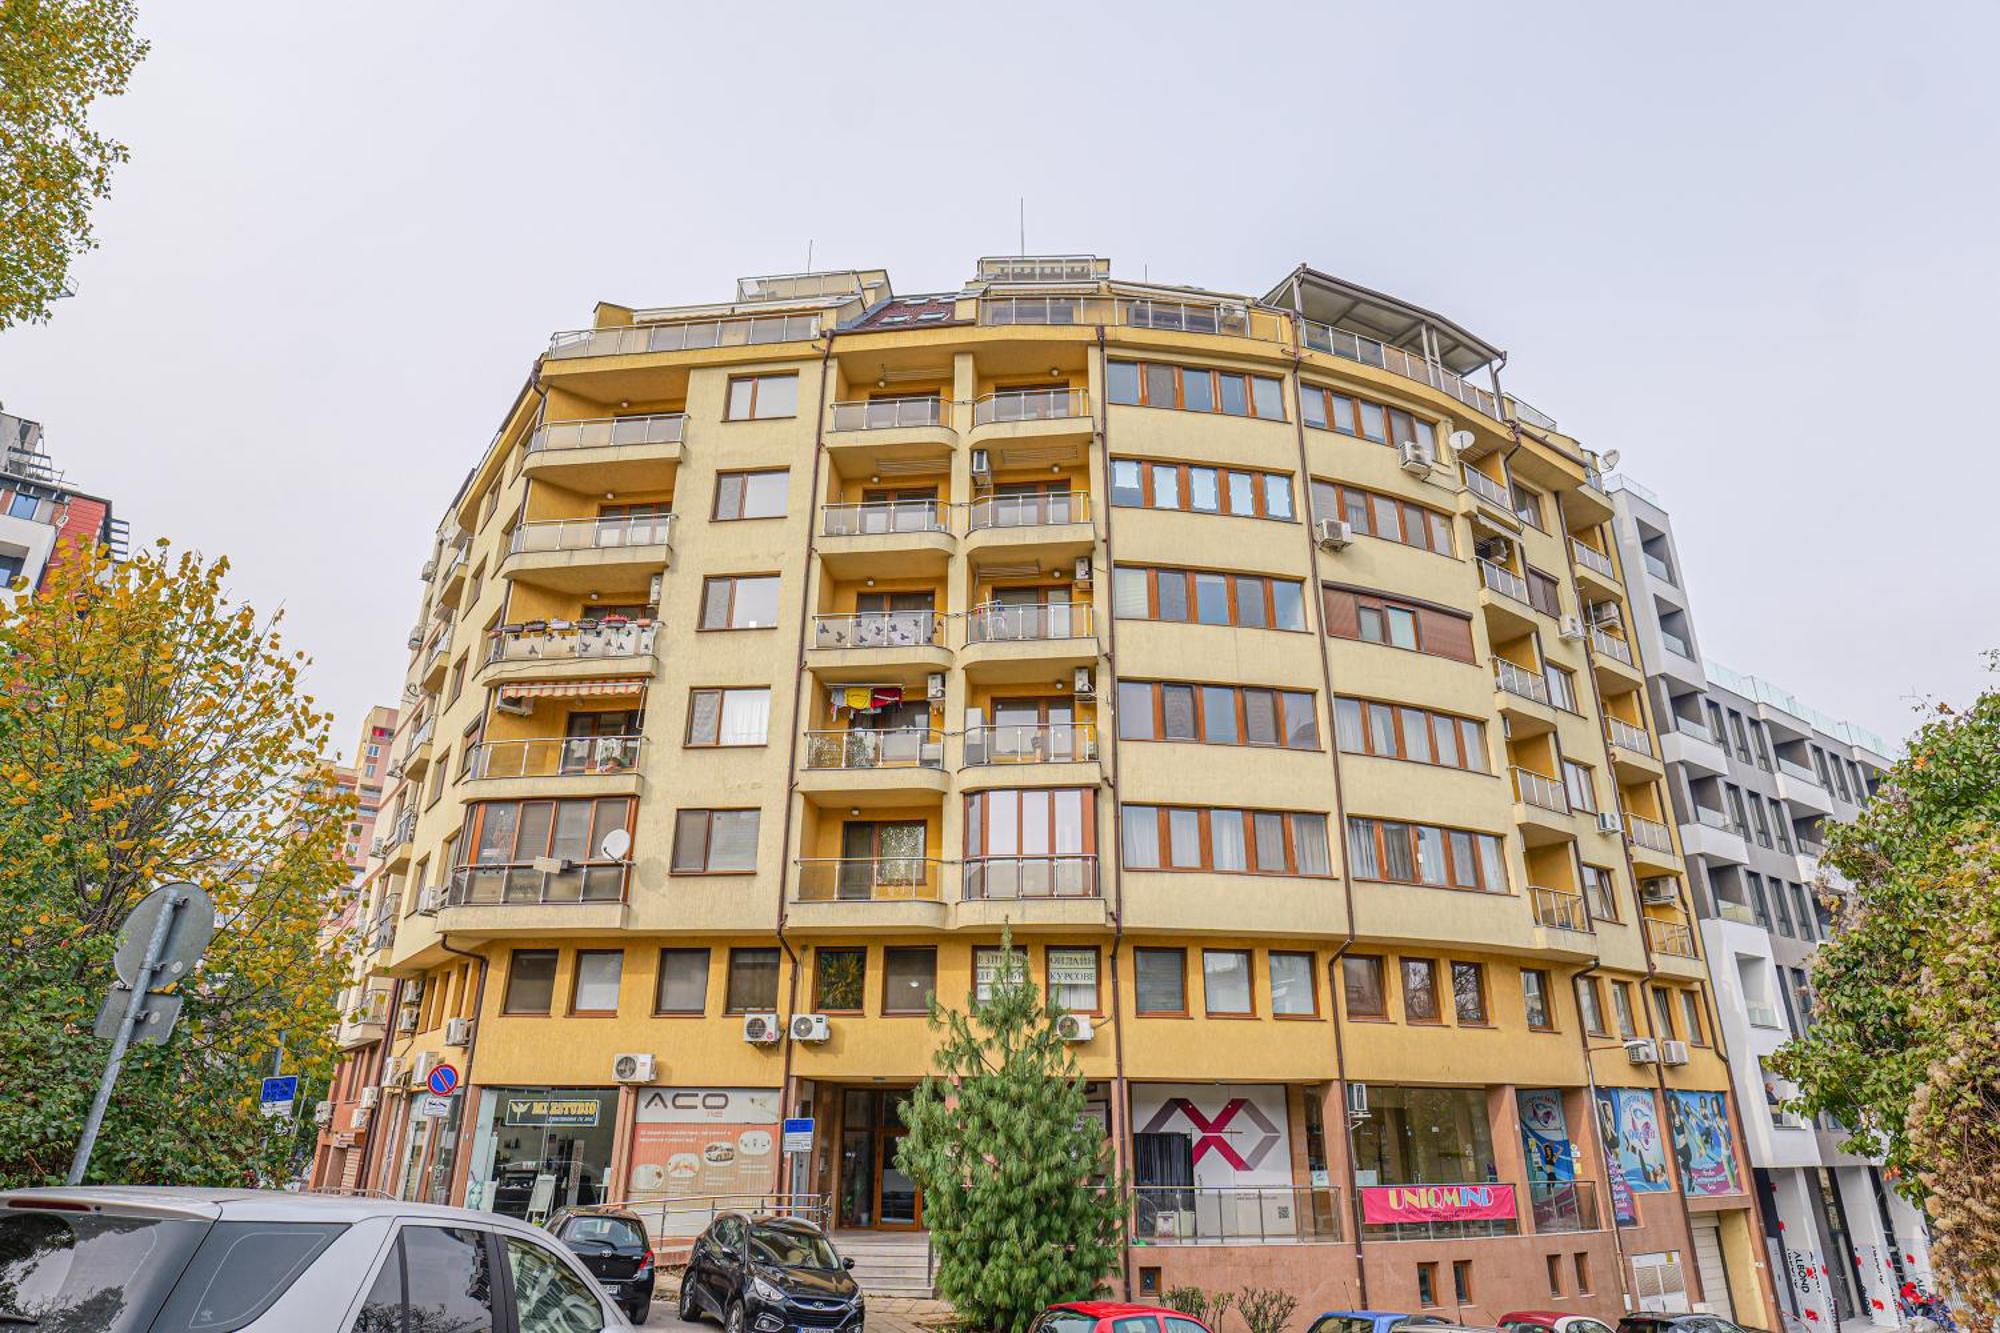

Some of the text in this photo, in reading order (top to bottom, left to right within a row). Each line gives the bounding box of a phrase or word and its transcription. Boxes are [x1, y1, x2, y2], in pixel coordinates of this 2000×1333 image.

[1050, 971, 1095, 981] КУРСОВЕ
[644, 1092, 729, 1110] ACO
[1388, 1186, 1494, 1210] UNIQMIND
[1793, 1250, 1810, 1294] ALBOND
